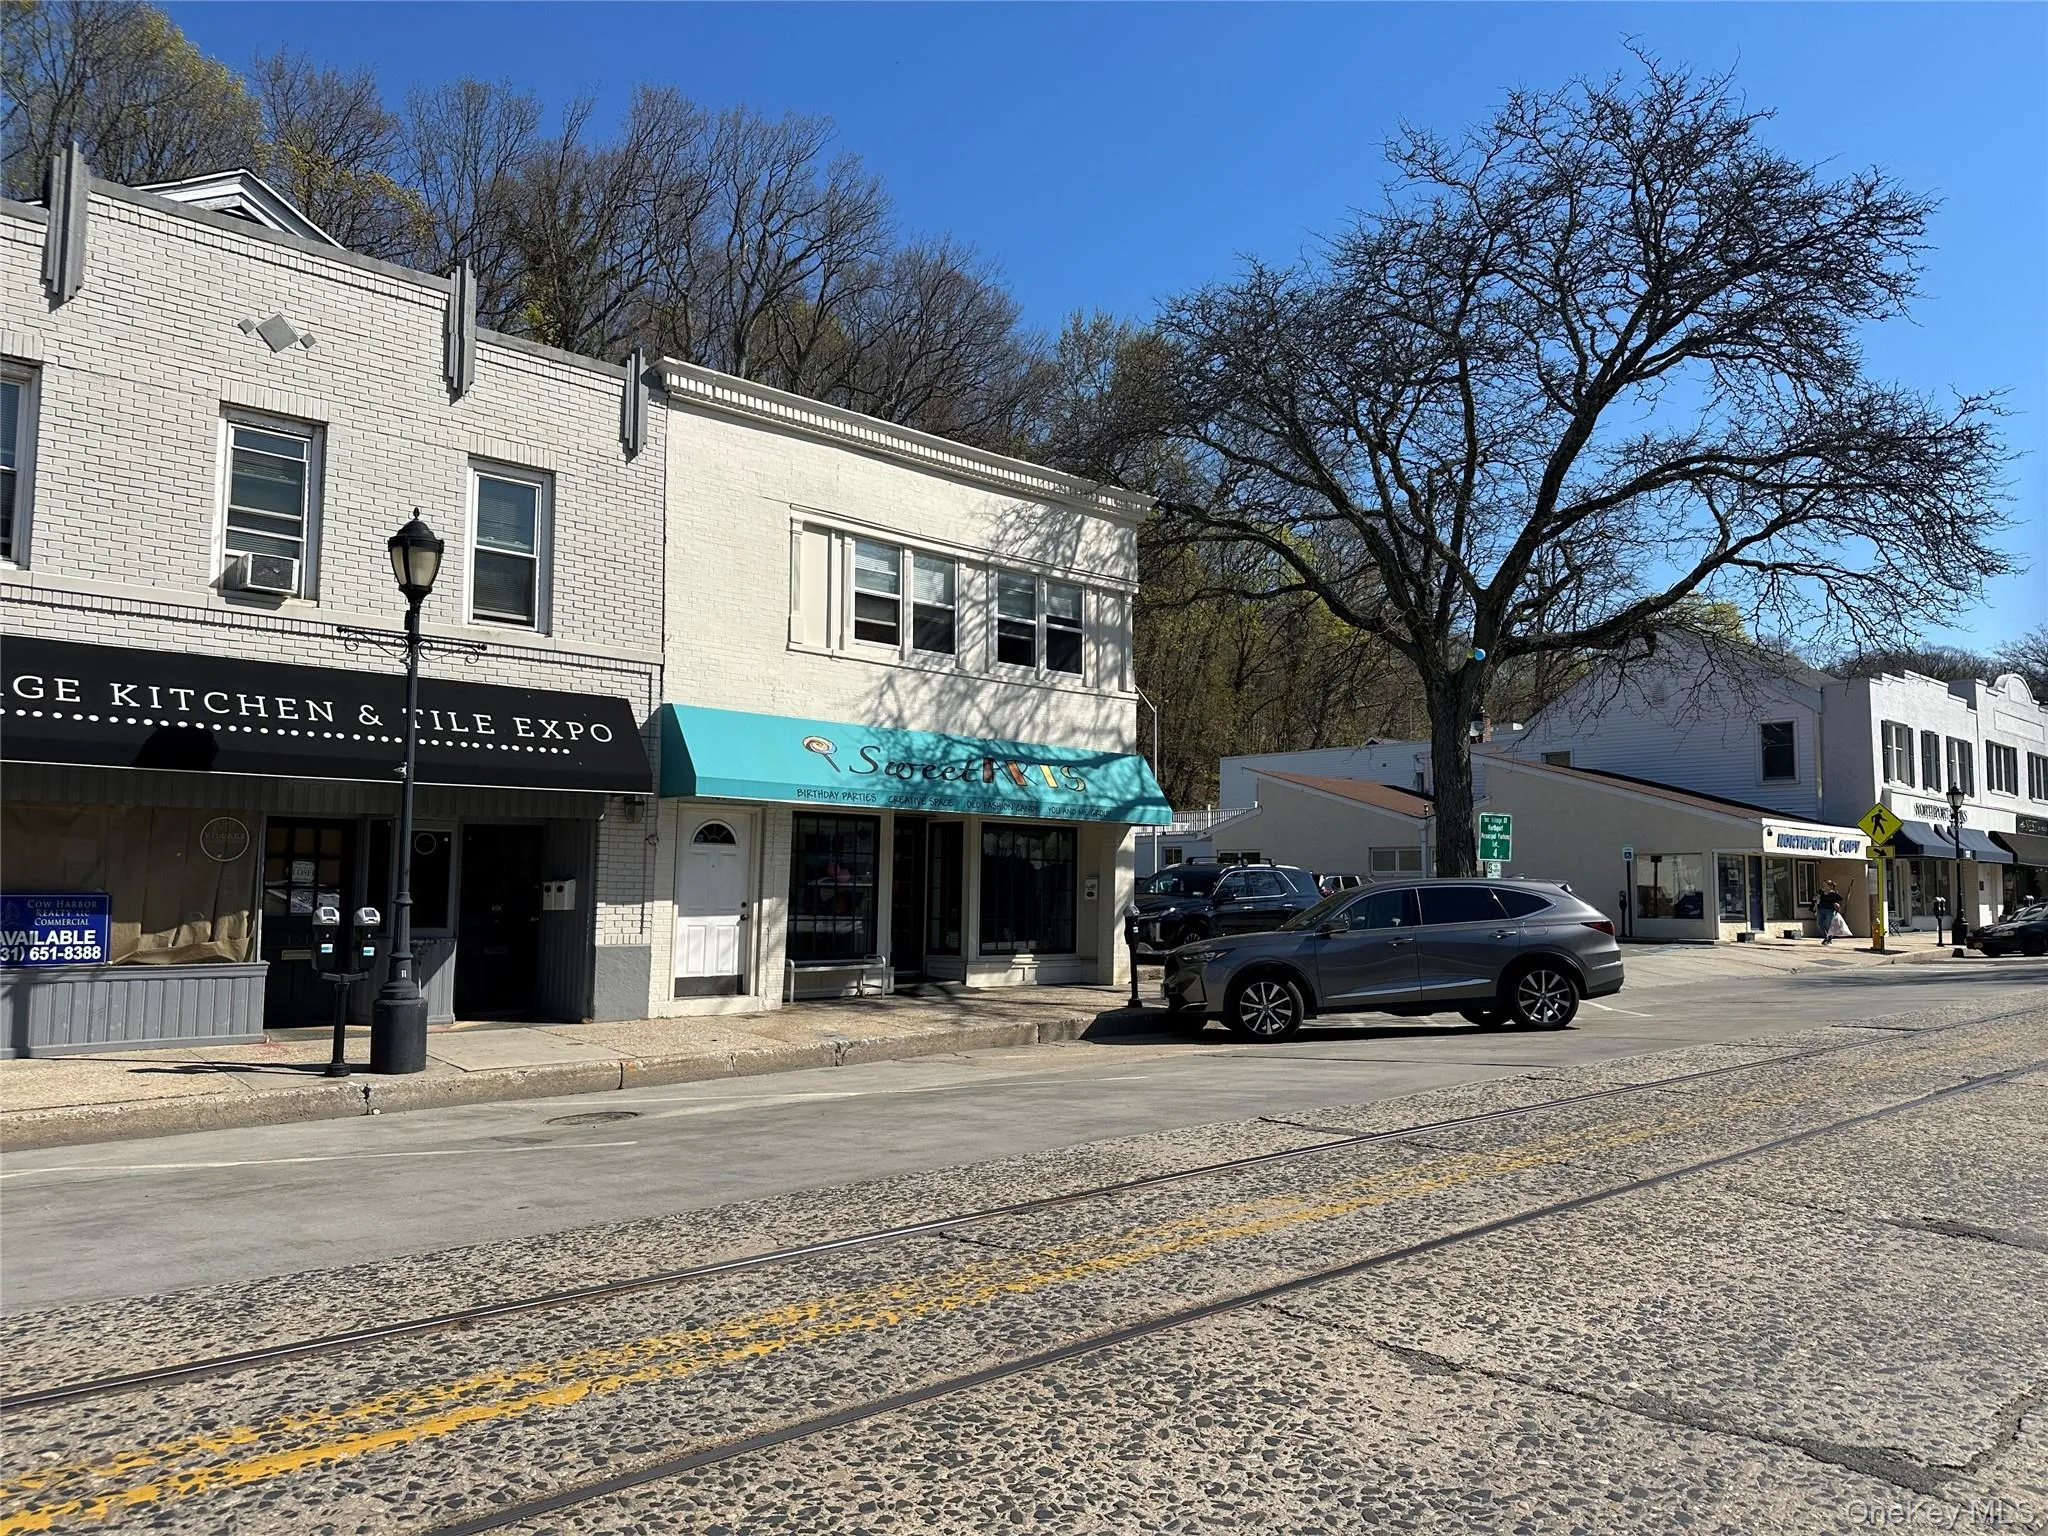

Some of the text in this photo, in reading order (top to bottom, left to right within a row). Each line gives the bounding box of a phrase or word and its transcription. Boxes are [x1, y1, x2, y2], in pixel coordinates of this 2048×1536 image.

[0, 675, 613, 743] GE KITCHEN & TILE EXPO
[797, 788, 839, 800] BIRTHDAY
[842, 791, 877, 803] PARTIES
[888, 795, 927, 806] CREATIVE
[929, 798, 954, 808] SPACE
[983, 801, 1014, 812] FASHION
[1777, 833, 1860, 853] NORTHPORT COPY
[27, 899, 97, 909] COW HARBOR
[36, 908, 72, 917] REALTY
[34, 917, 89, 926] COMMERCIAL
[29, 946, 101, 960] 651-8388
